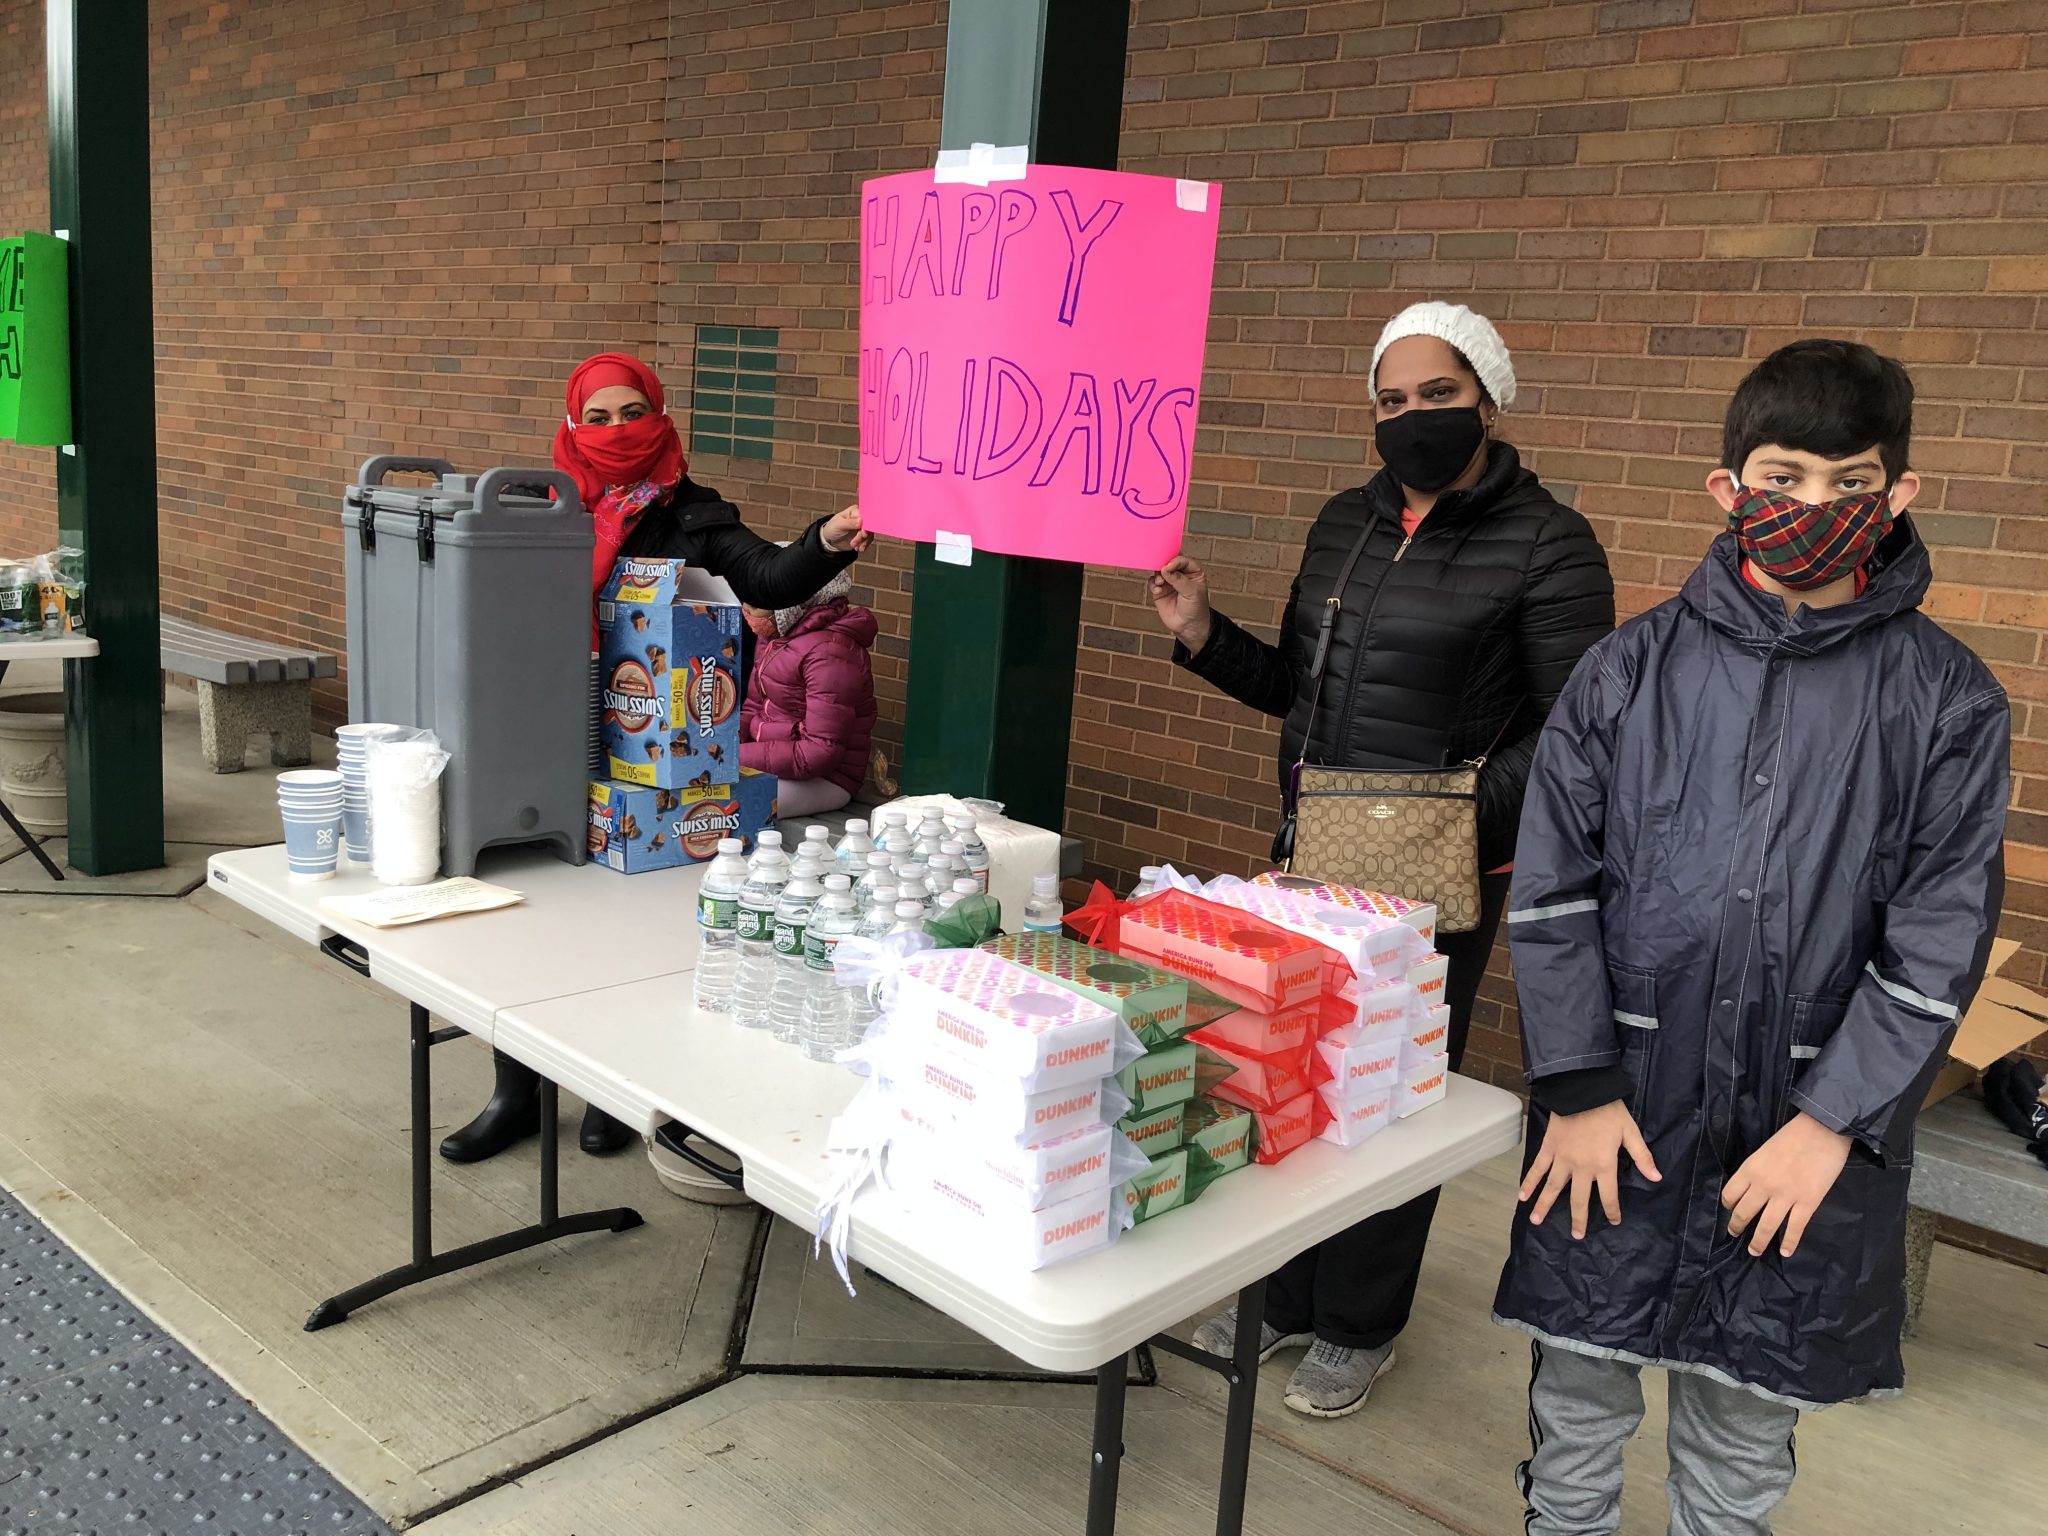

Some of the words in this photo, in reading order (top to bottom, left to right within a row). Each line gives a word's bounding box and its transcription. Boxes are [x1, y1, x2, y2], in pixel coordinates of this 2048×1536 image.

[865, 189, 1123, 326] HAPPY
[862, 347, 1194, 519] HOLIDAYS
[622, 561, 644, 576] MISS
[645, 563, 673, 577] SWISS
[701, 656, 717, 692] MISS
[604, 689, 628, 712] MISS
[629, 696, 665, 717] SWISS
[673, 690, 683, 703] 50
[700, 694, 715, 737] SWISS
[628, 767, 638, 780] 50
[702, 786, 713, 797] 50
[593, 814, 613, 834] MISS
[671, 818, 708, 839] SWISS
[710, 813, 740, 830] MISS
[1163, 947, 1187, 961] AMERICA
[1188, 955, 1203, 966] RUNS
[1204, 960, 1213, 969] ON
[937, 1015, 988, 1049] DUNKIN'
[1046, 1039, 1110, 1068] DUNKIN'
[1136, 1065, 1190, 1091] DUNKIN'
[1350, 1056, 1395, 1079] DUNKIN'
[1034, 1091, 1097, 1124] DUNKIN'
[1045, 1152, 1106, 1185] DUNKIN'
[1043, 1211, 1105, 1246] DUNKIN'
